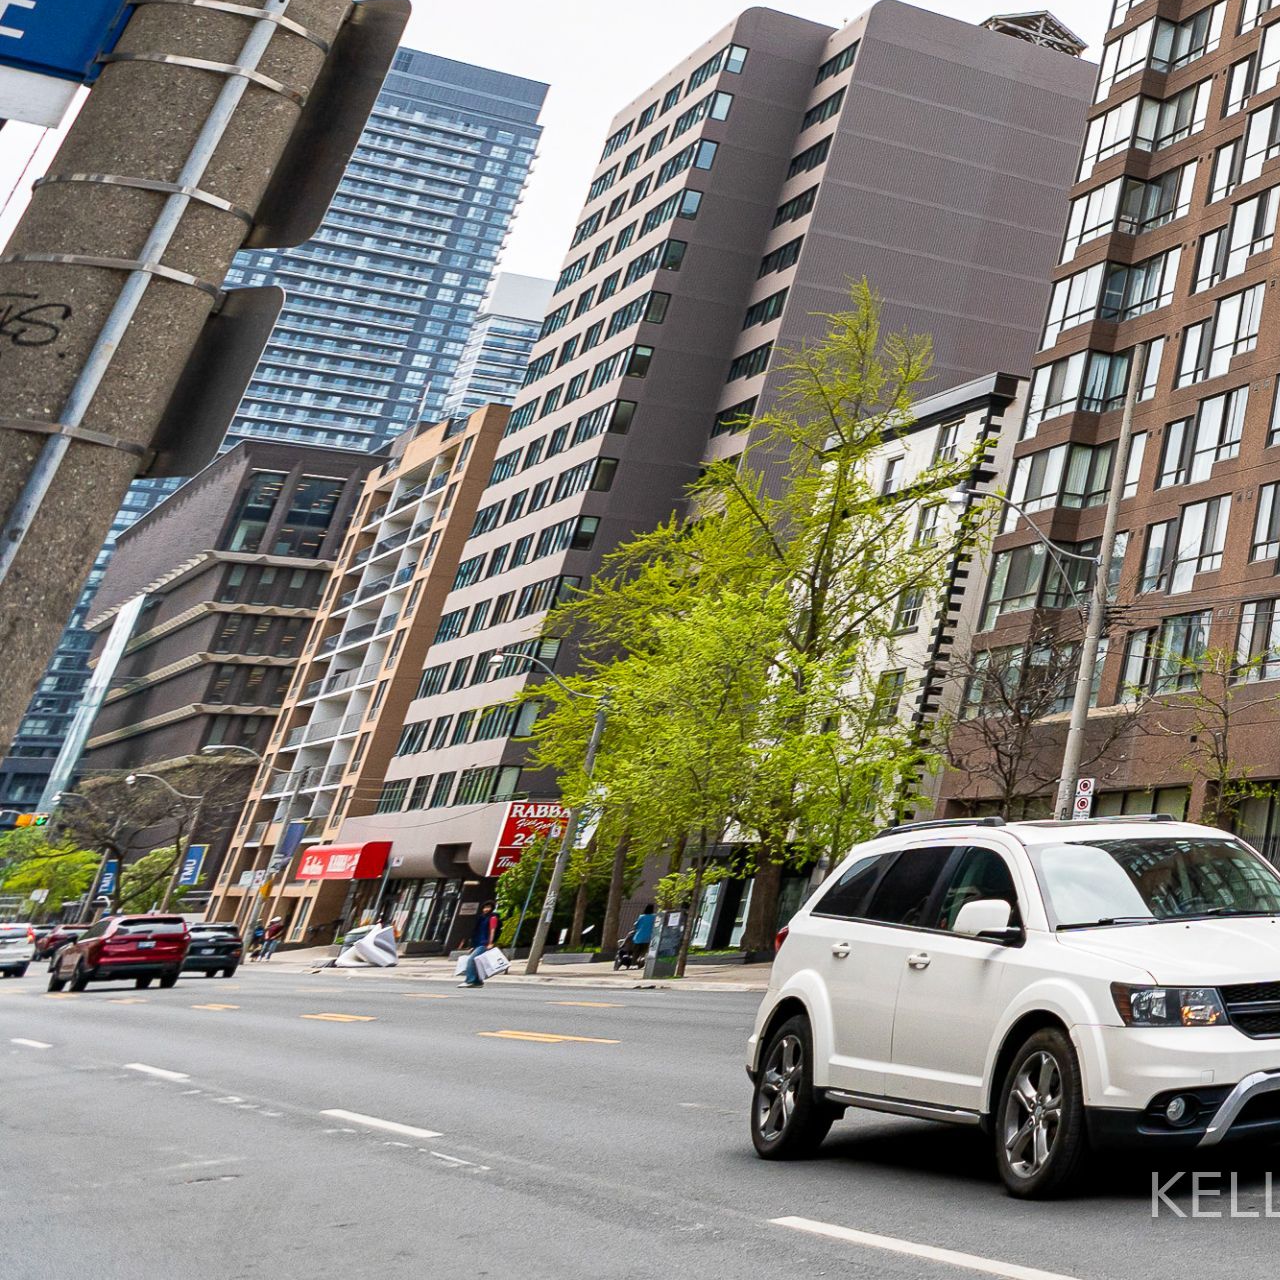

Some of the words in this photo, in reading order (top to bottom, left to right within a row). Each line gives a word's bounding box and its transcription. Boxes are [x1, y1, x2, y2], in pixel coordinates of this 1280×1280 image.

[510, 804, 572, 819] RABBA
[511, 833, 537, 847] 24
[179, 859, 197, 883] TMU
